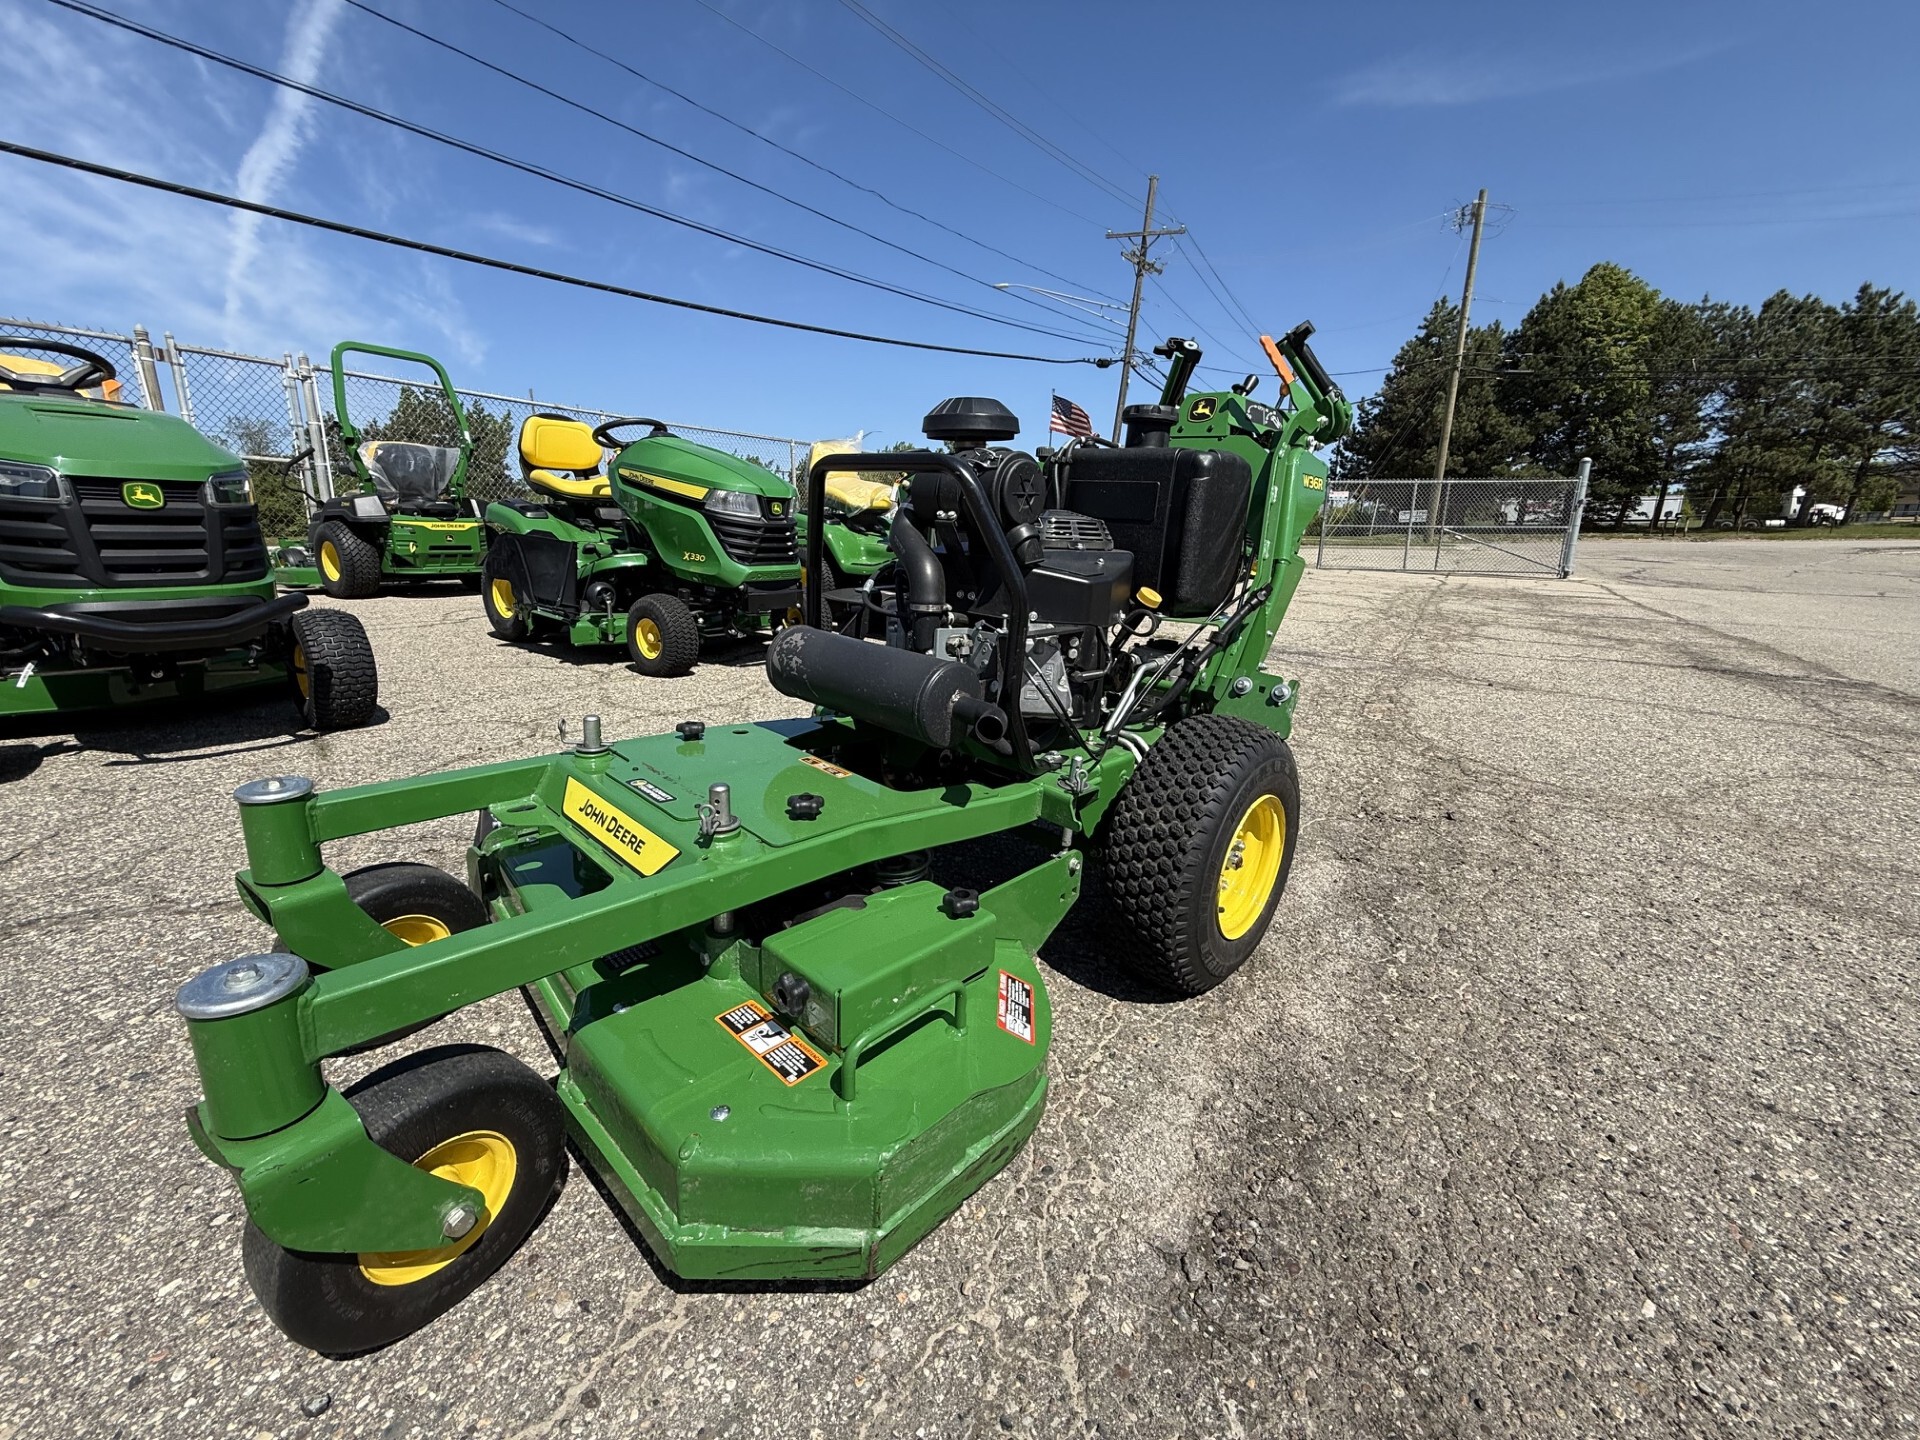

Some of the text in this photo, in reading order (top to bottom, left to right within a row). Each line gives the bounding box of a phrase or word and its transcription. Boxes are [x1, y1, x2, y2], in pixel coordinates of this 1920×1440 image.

[628, 470, 654, 485] JOHN DEERE
[1302, 472, 1324, 492] W36R
[682, 551, 706, 562] X330
[578, 798, 646, 856] JOHN DEERE
